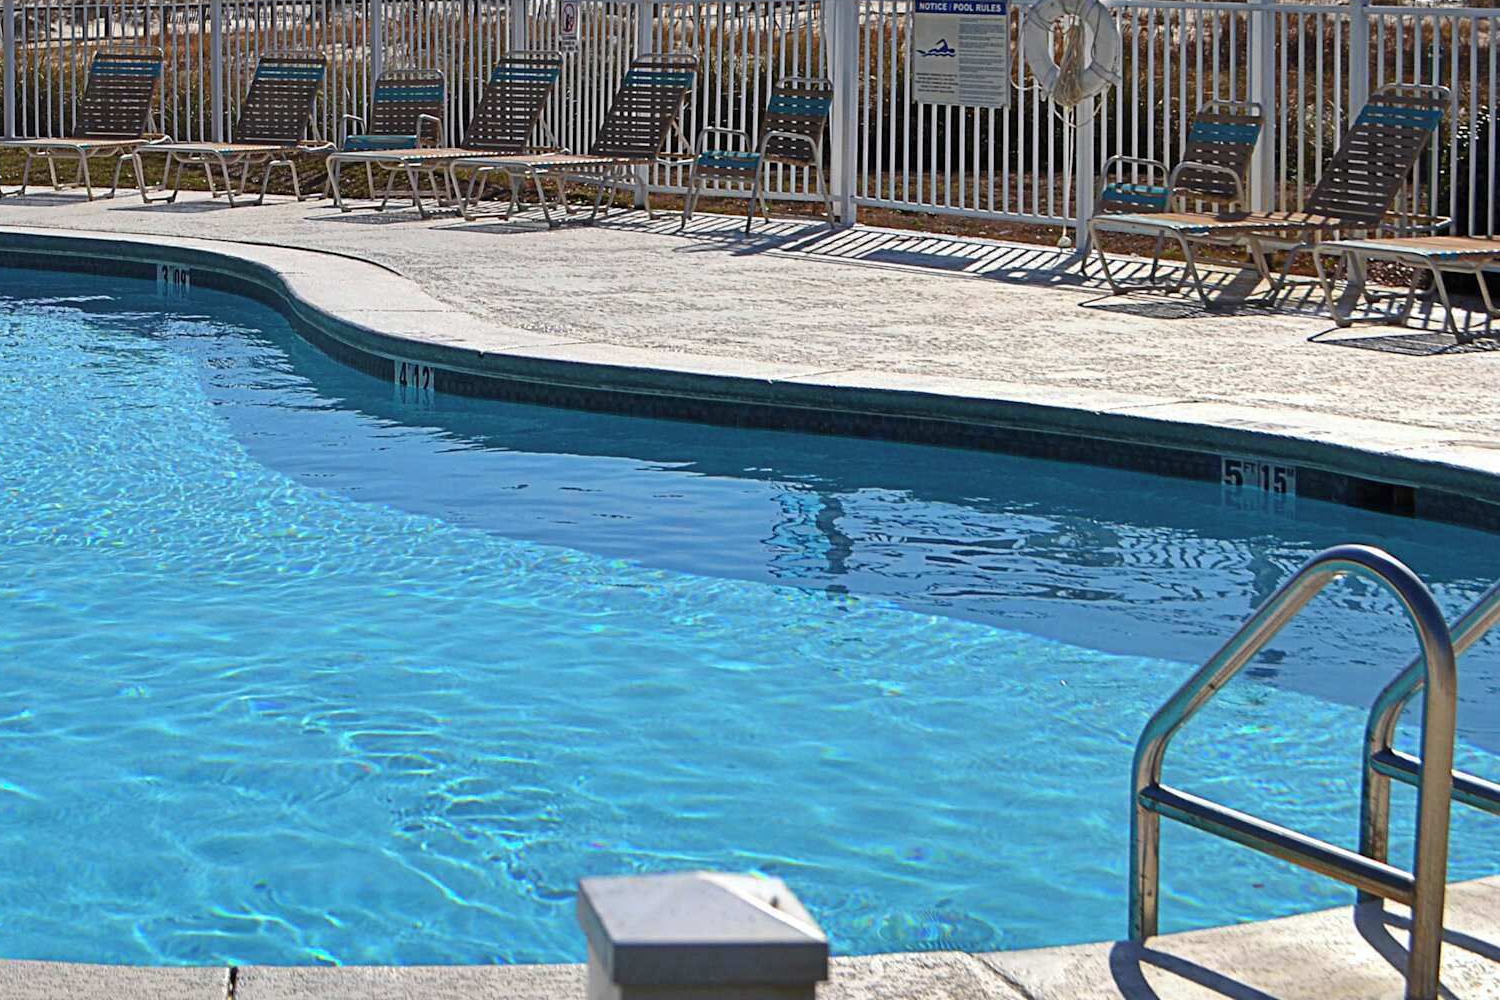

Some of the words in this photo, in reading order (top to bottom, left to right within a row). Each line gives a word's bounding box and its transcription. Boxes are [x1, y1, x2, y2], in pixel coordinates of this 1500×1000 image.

[919, 2, 947, 11] NOTICE
[953, 3, 974, 12] POOL
[975, 3, 1002, 13] RULES
